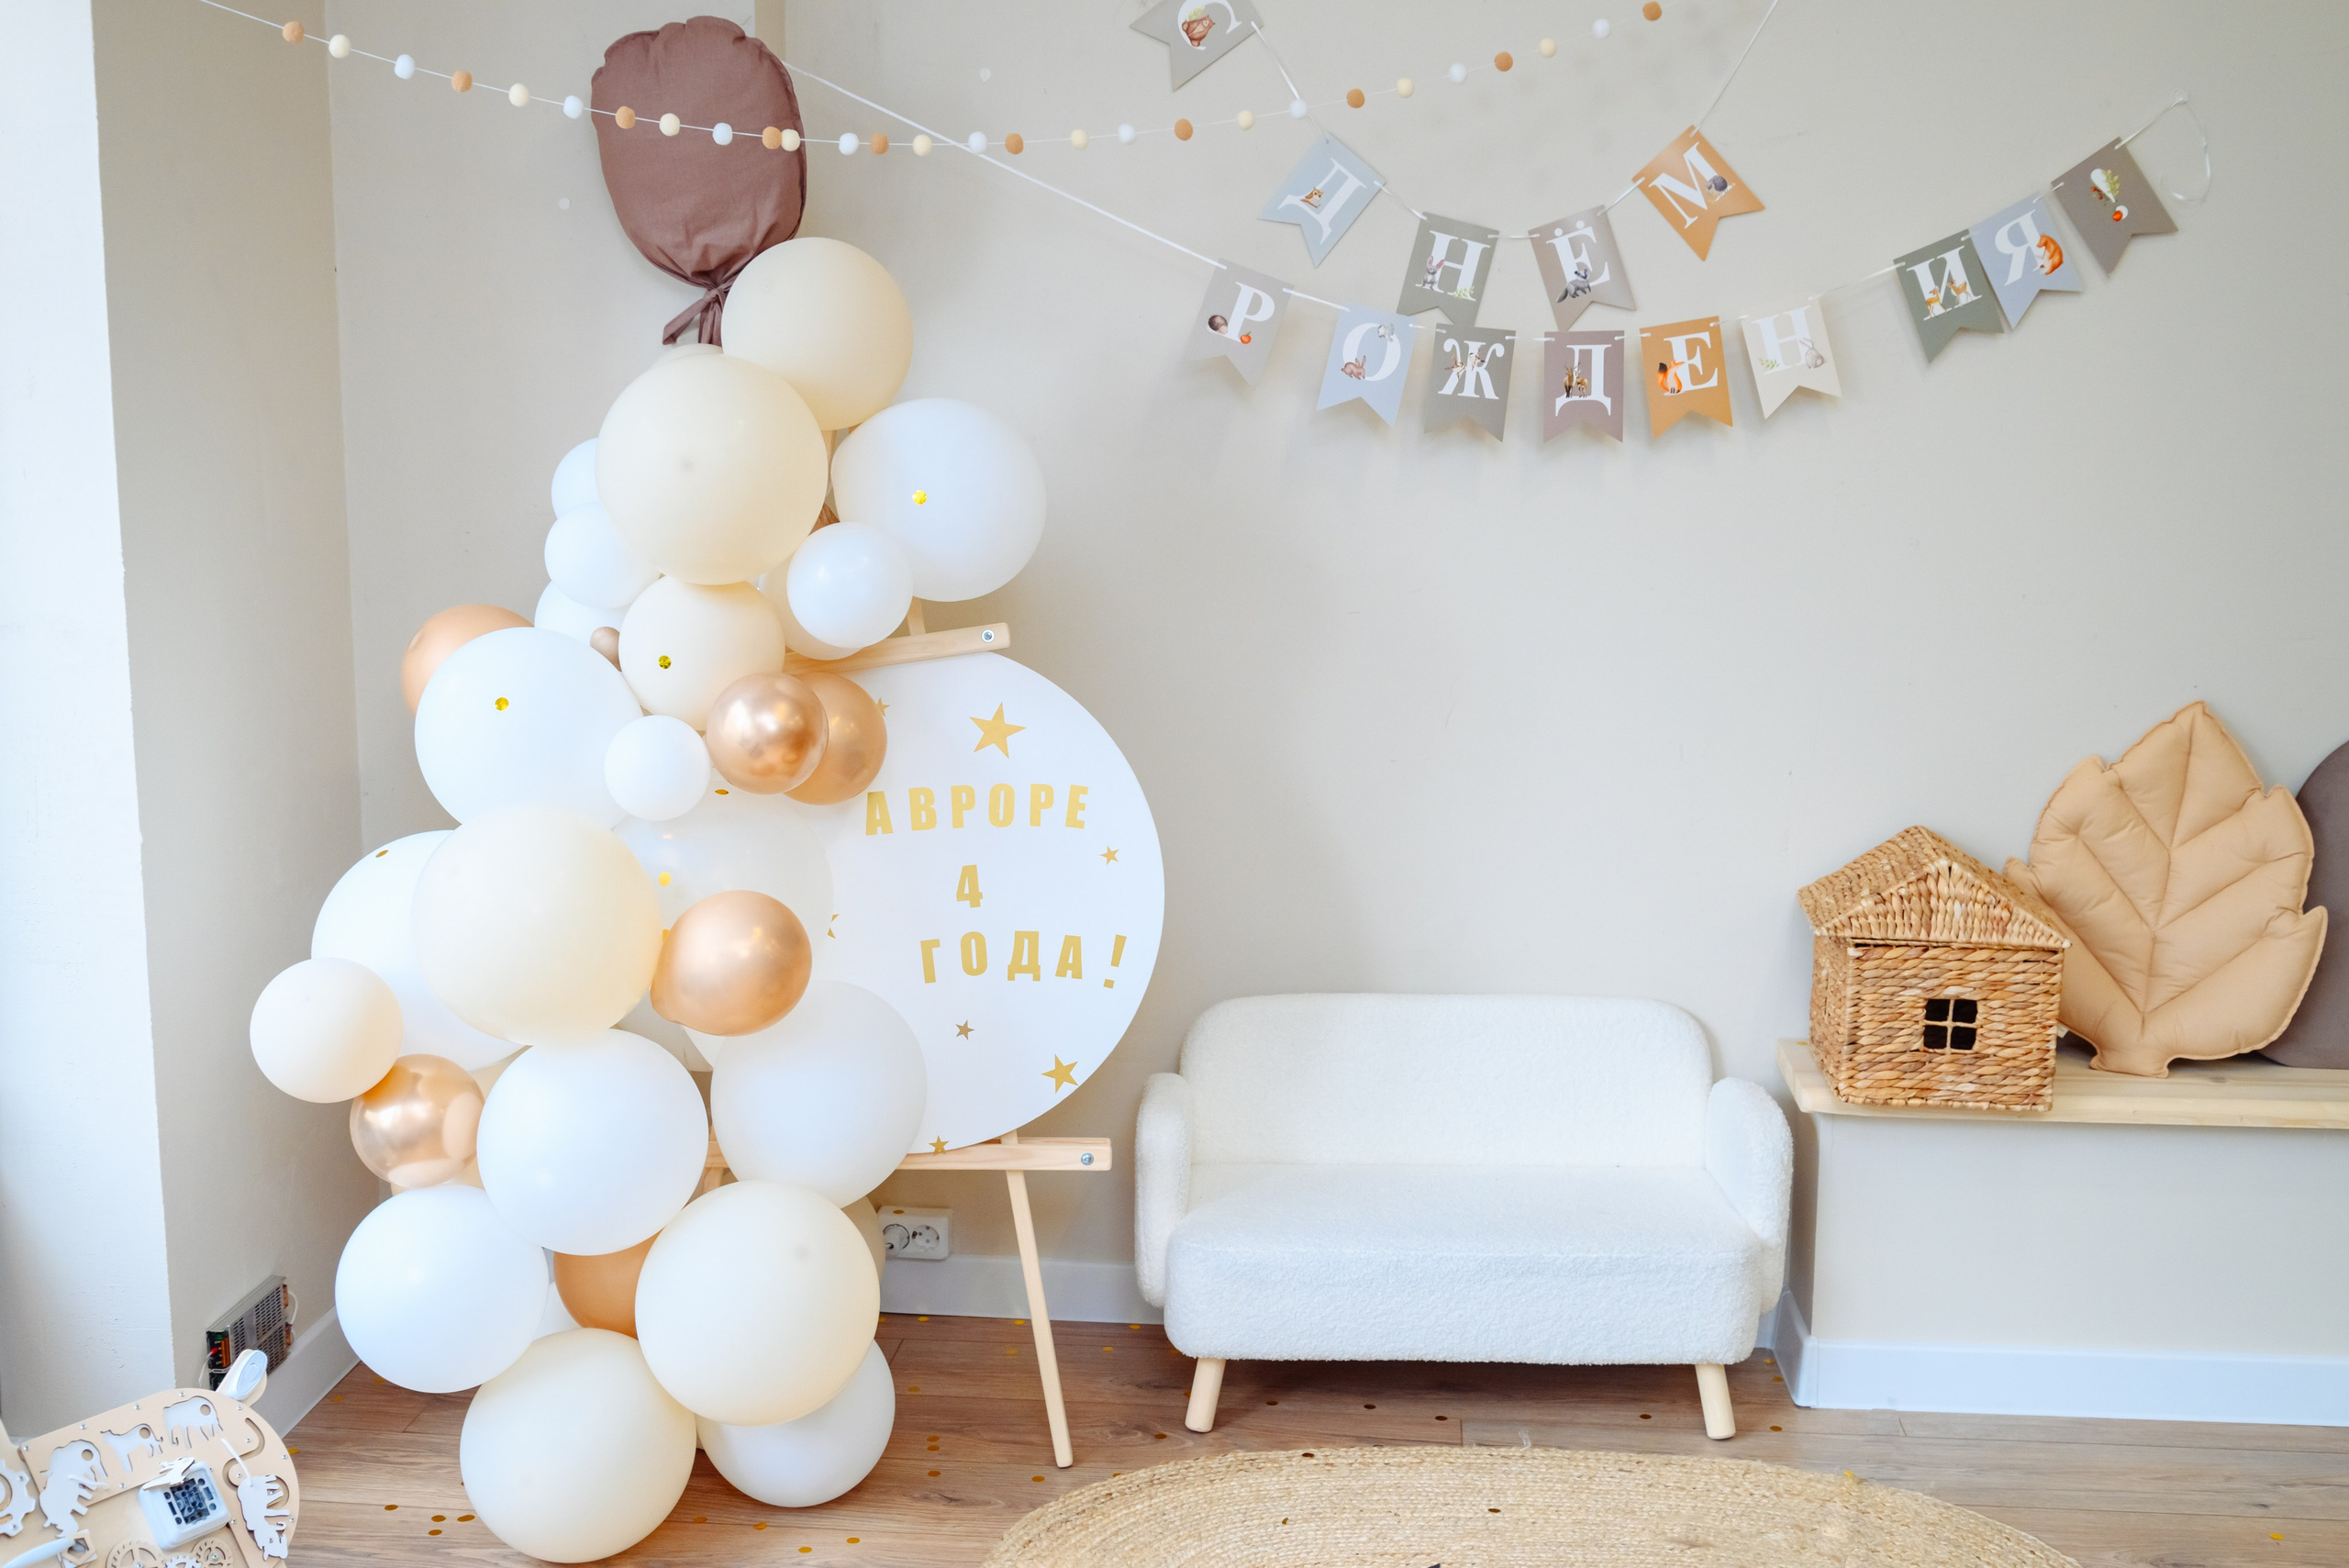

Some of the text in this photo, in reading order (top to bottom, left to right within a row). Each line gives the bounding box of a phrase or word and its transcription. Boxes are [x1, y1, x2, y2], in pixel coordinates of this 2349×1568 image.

[865, 783, 1090, 836] АВРОРЕ
[955, 864, 984, 908] 4
[920, 930, 1128, 989] ГОДА!
